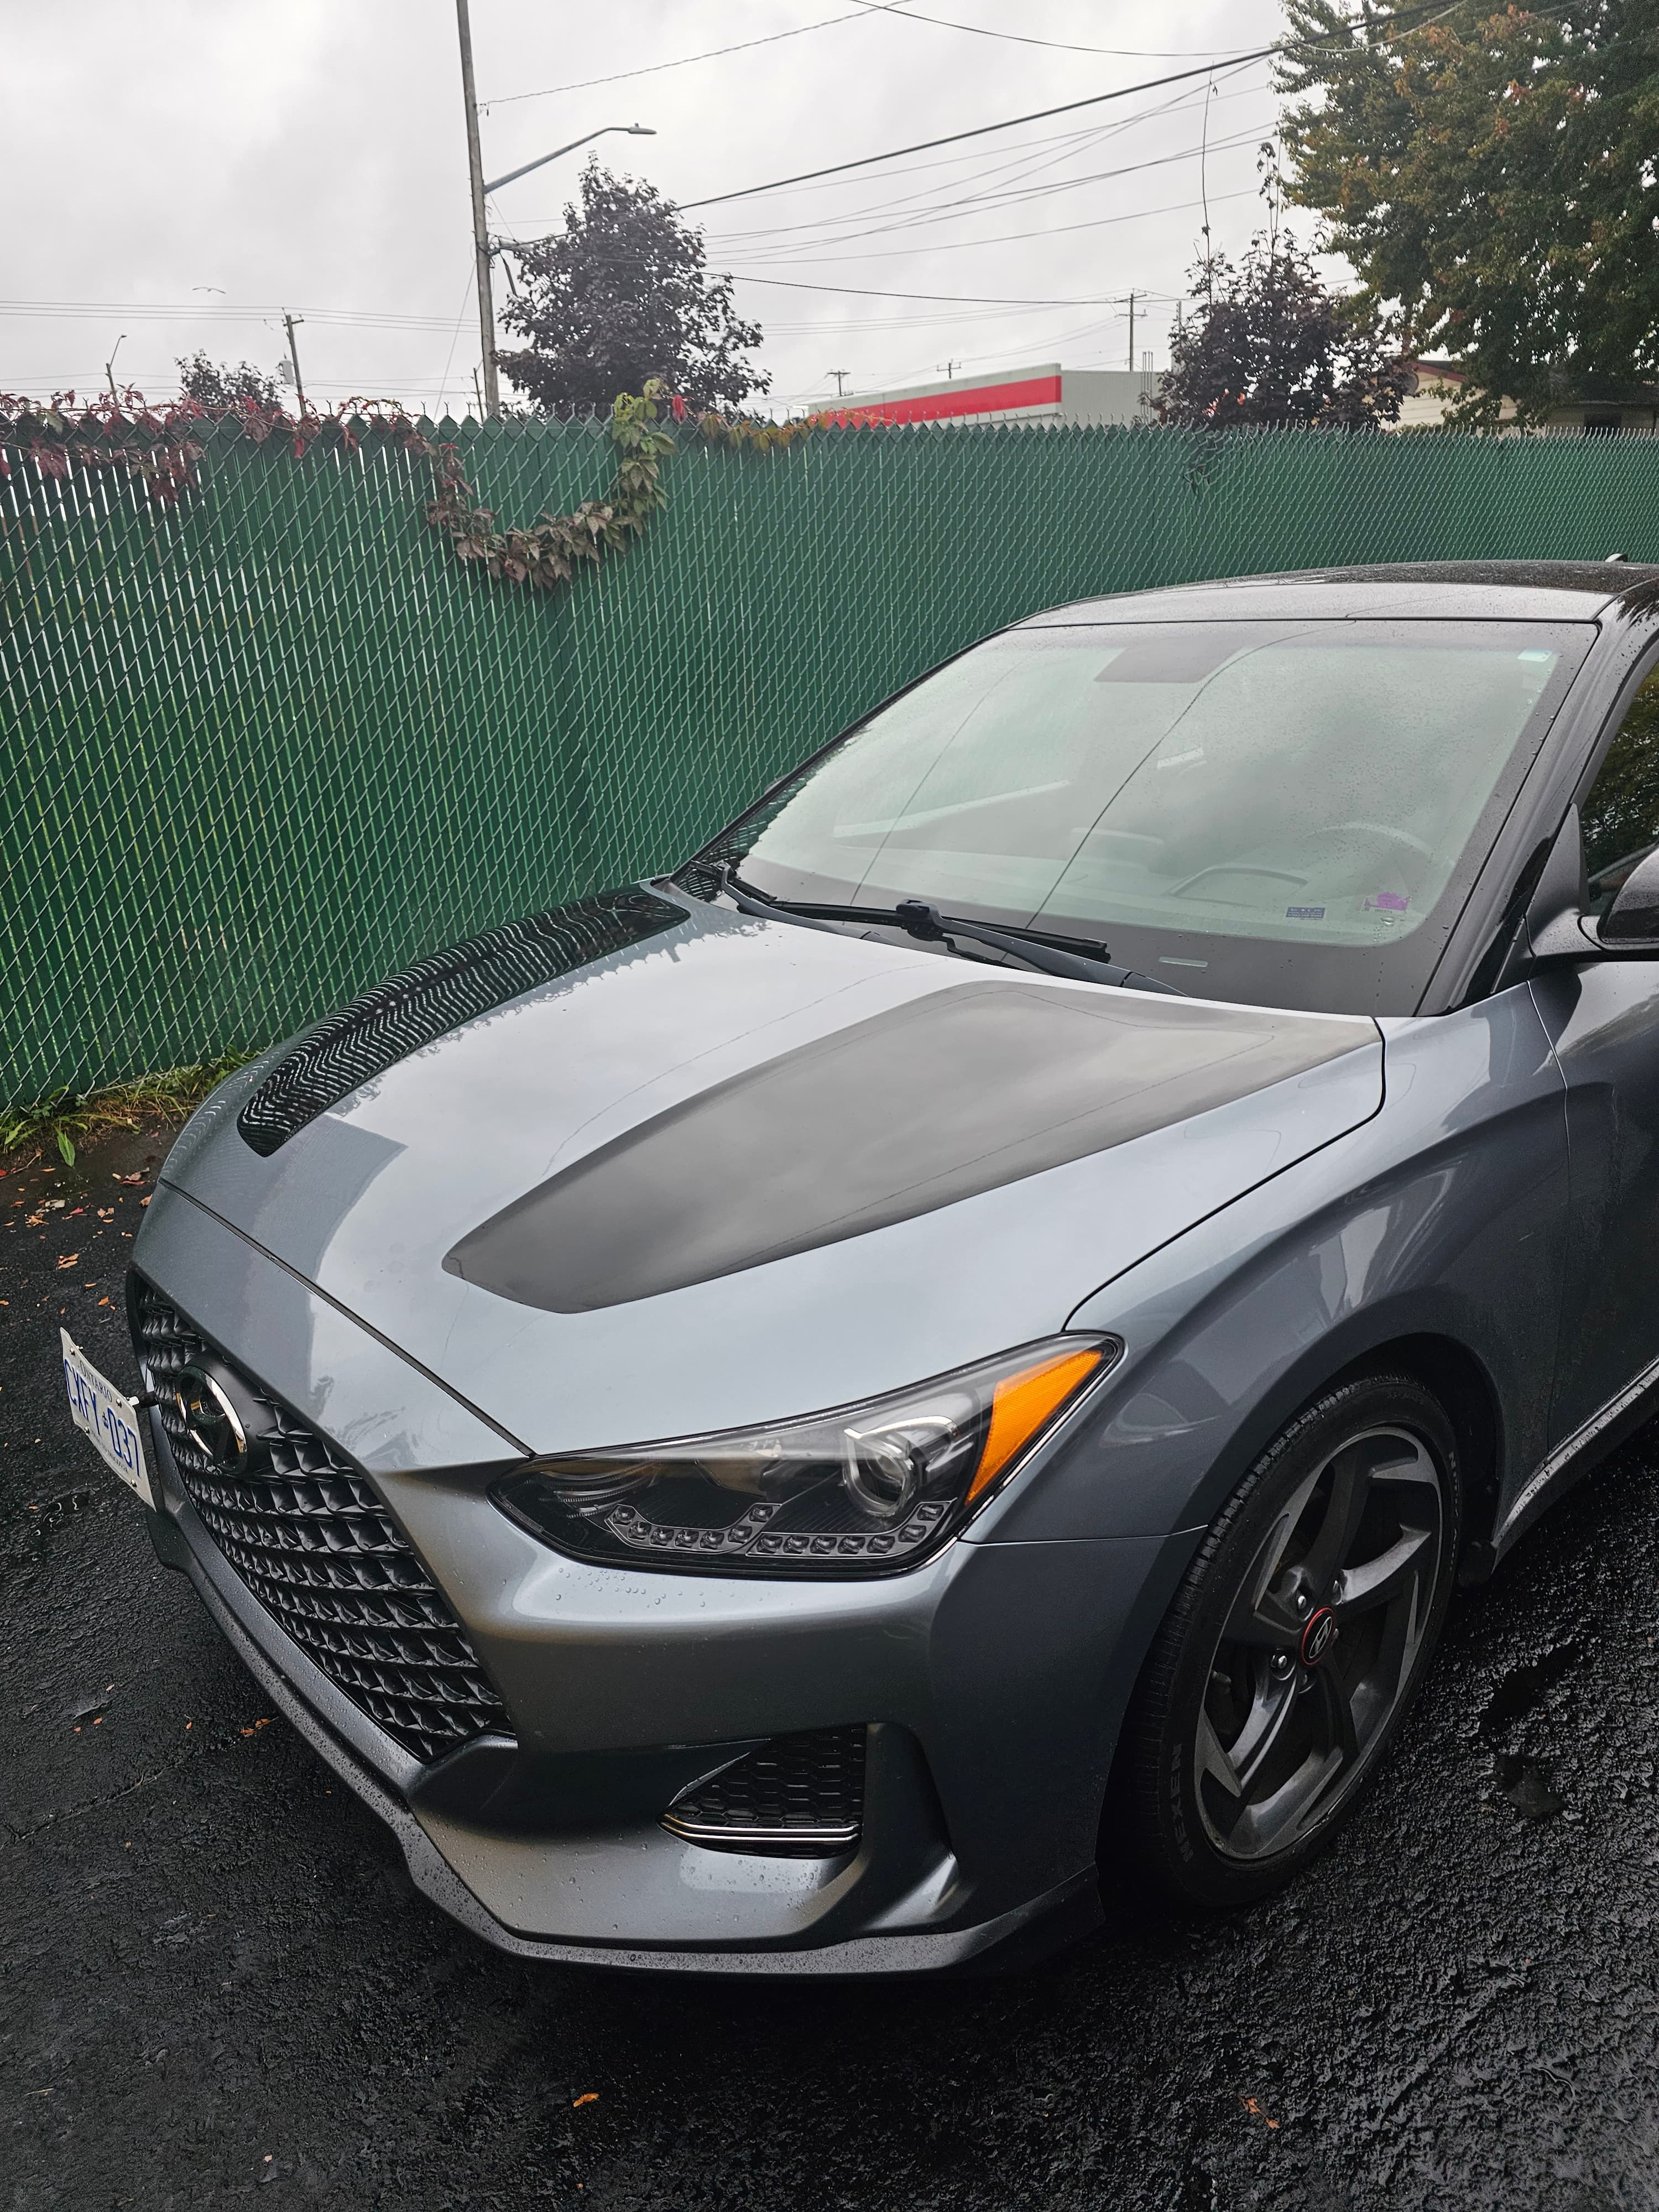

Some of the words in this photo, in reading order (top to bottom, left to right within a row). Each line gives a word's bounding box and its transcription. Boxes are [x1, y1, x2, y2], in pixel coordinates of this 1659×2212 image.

[64, 1359, 101, 1436] CXFY
[107, 1407, 140, 1478] 037
[80, 1360, 112, 1402] ONTARIO
[1170, 1743, 1194, 1863] NEXEN
